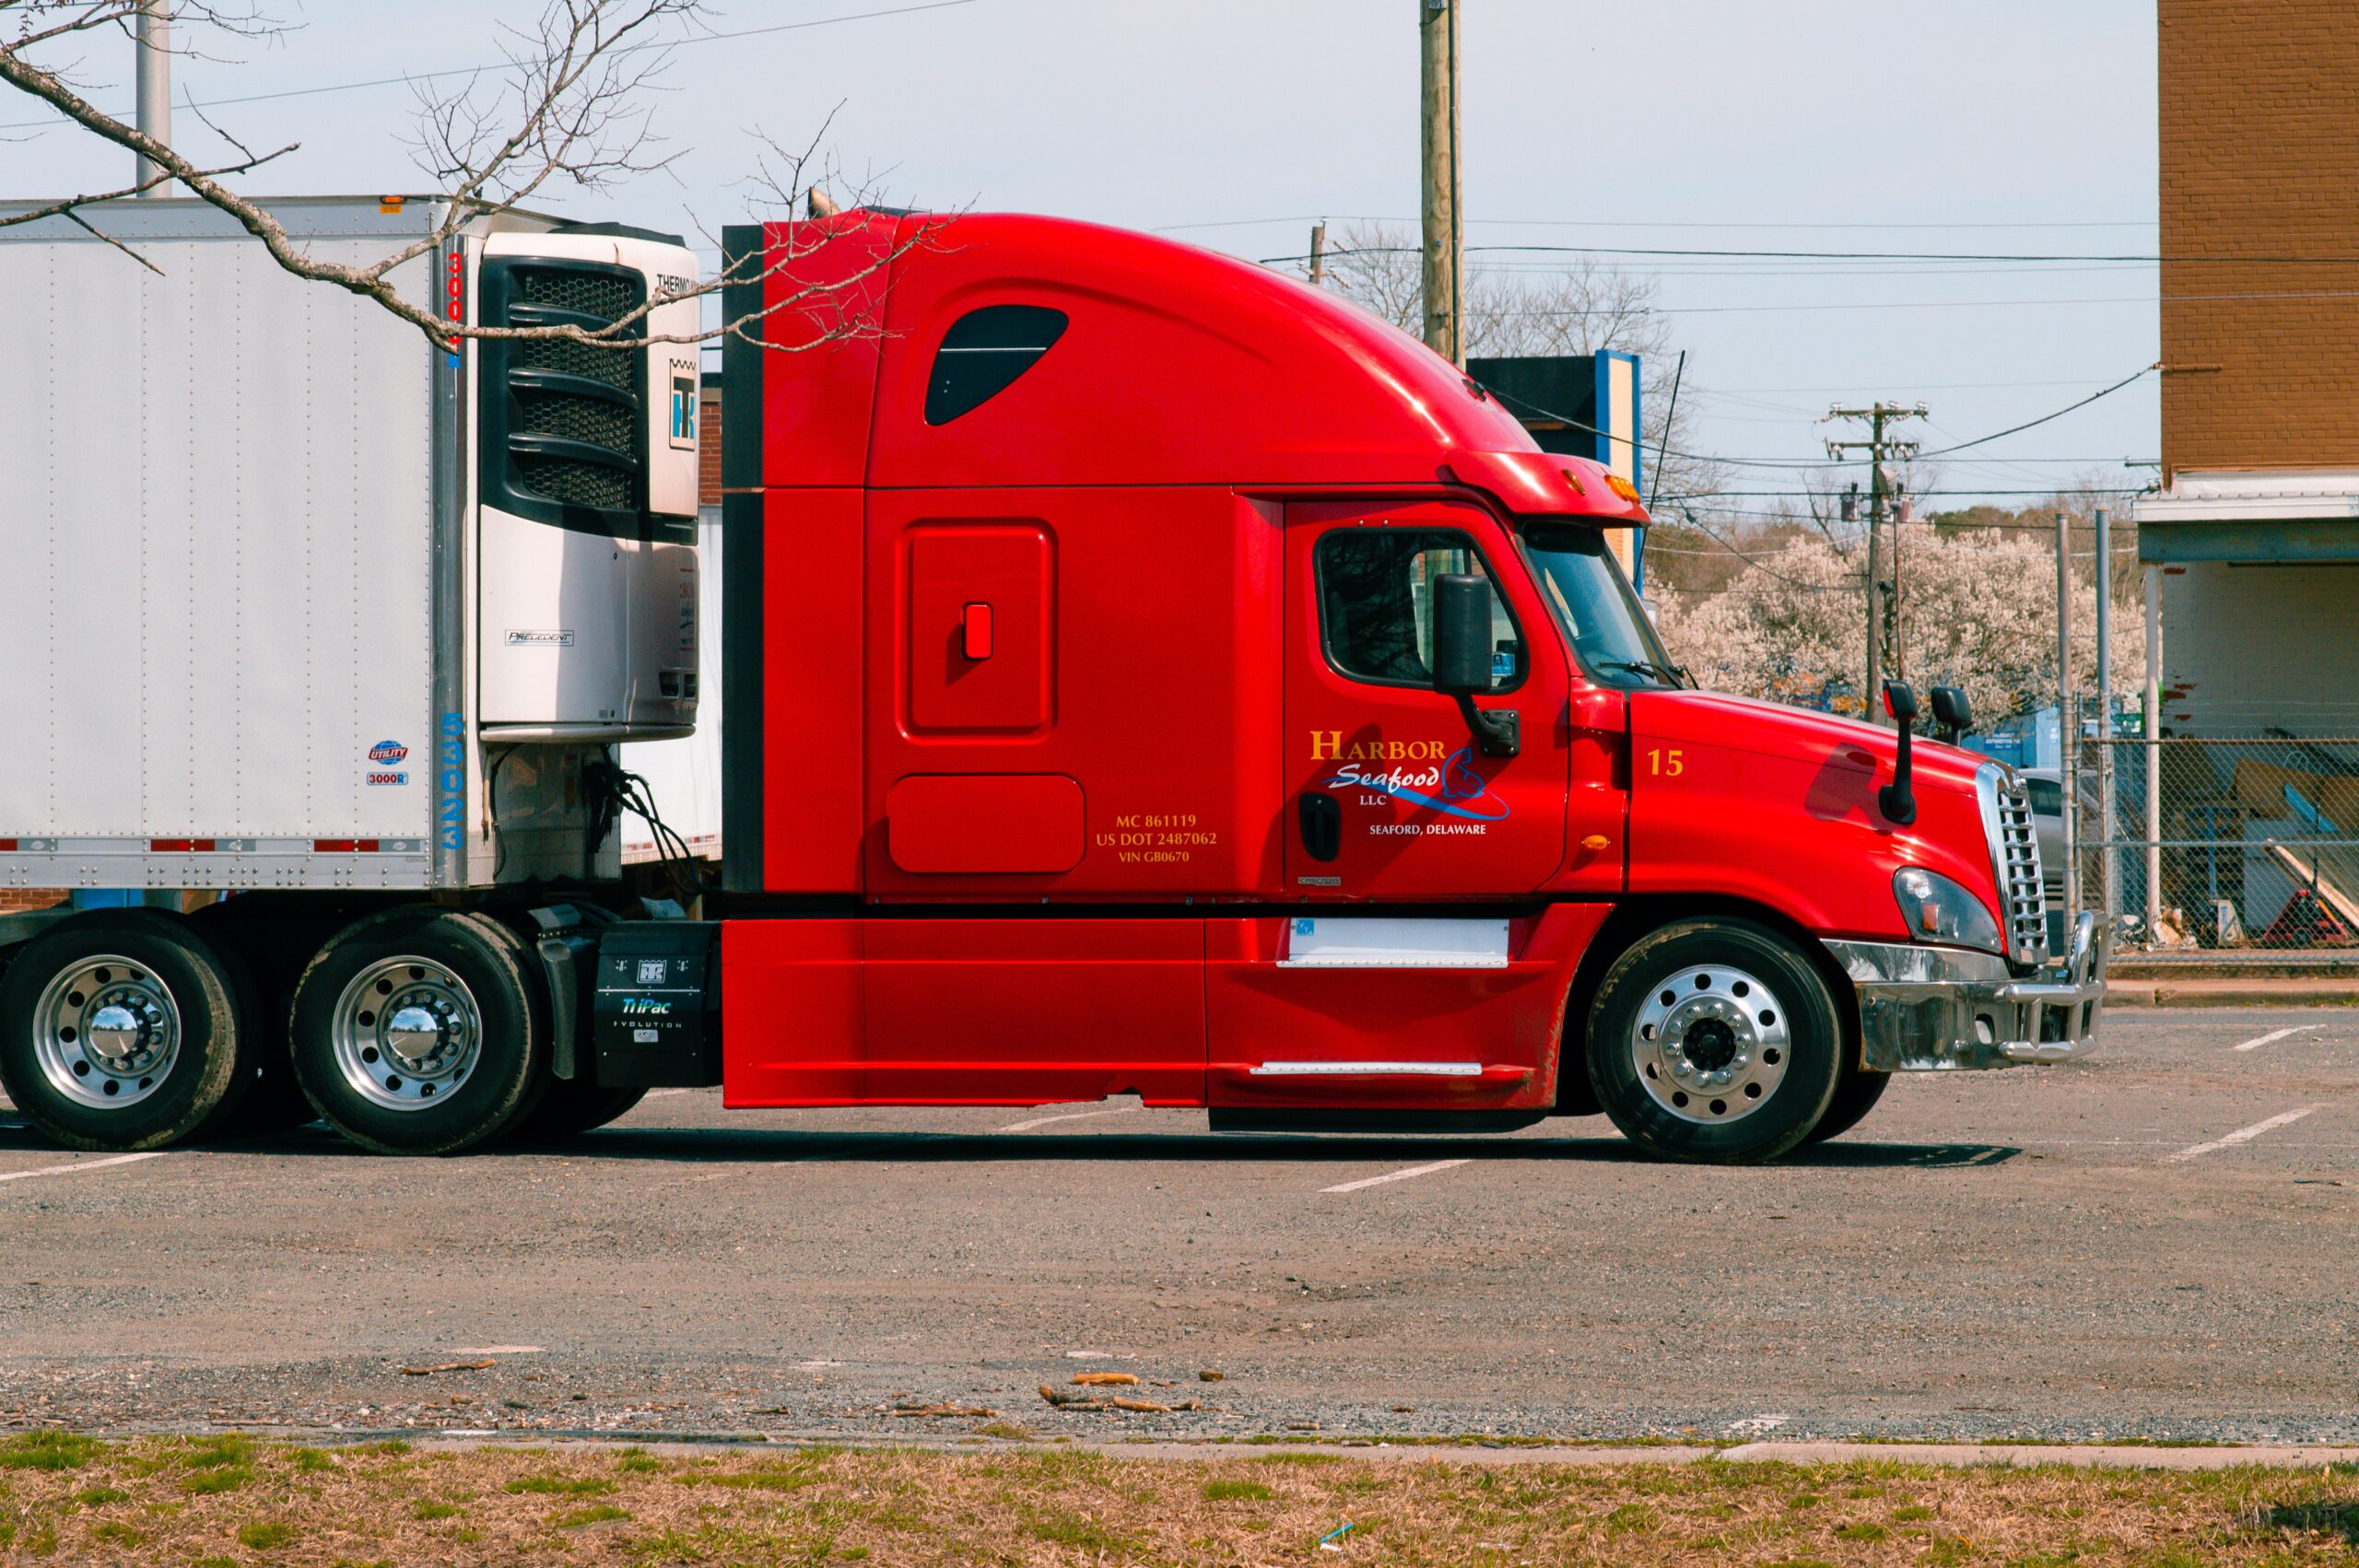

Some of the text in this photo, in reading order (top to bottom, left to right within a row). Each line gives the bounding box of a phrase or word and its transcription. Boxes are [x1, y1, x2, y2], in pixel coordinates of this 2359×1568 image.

[371, 747, 406, 759] UTILITY
[1309, 731, 1447, 760] HARBOR
[1647, 748, 1684, 777] 15
[440, 712, 464, 849] 53023
[1328, 763, 1439, 793] Seafood
[1359, 795, 1387, 806] LLC
[1116, 814, 1197, 827] MC 861119
[1369, 824, 1486, 837] SEAFORD, DELAWARE
[1096, 832, 1217, 847] US DOT 2487062
[1119, 851, 1190, 863] VIN GB0670
[623, 998, 672, 1014] TriPac
